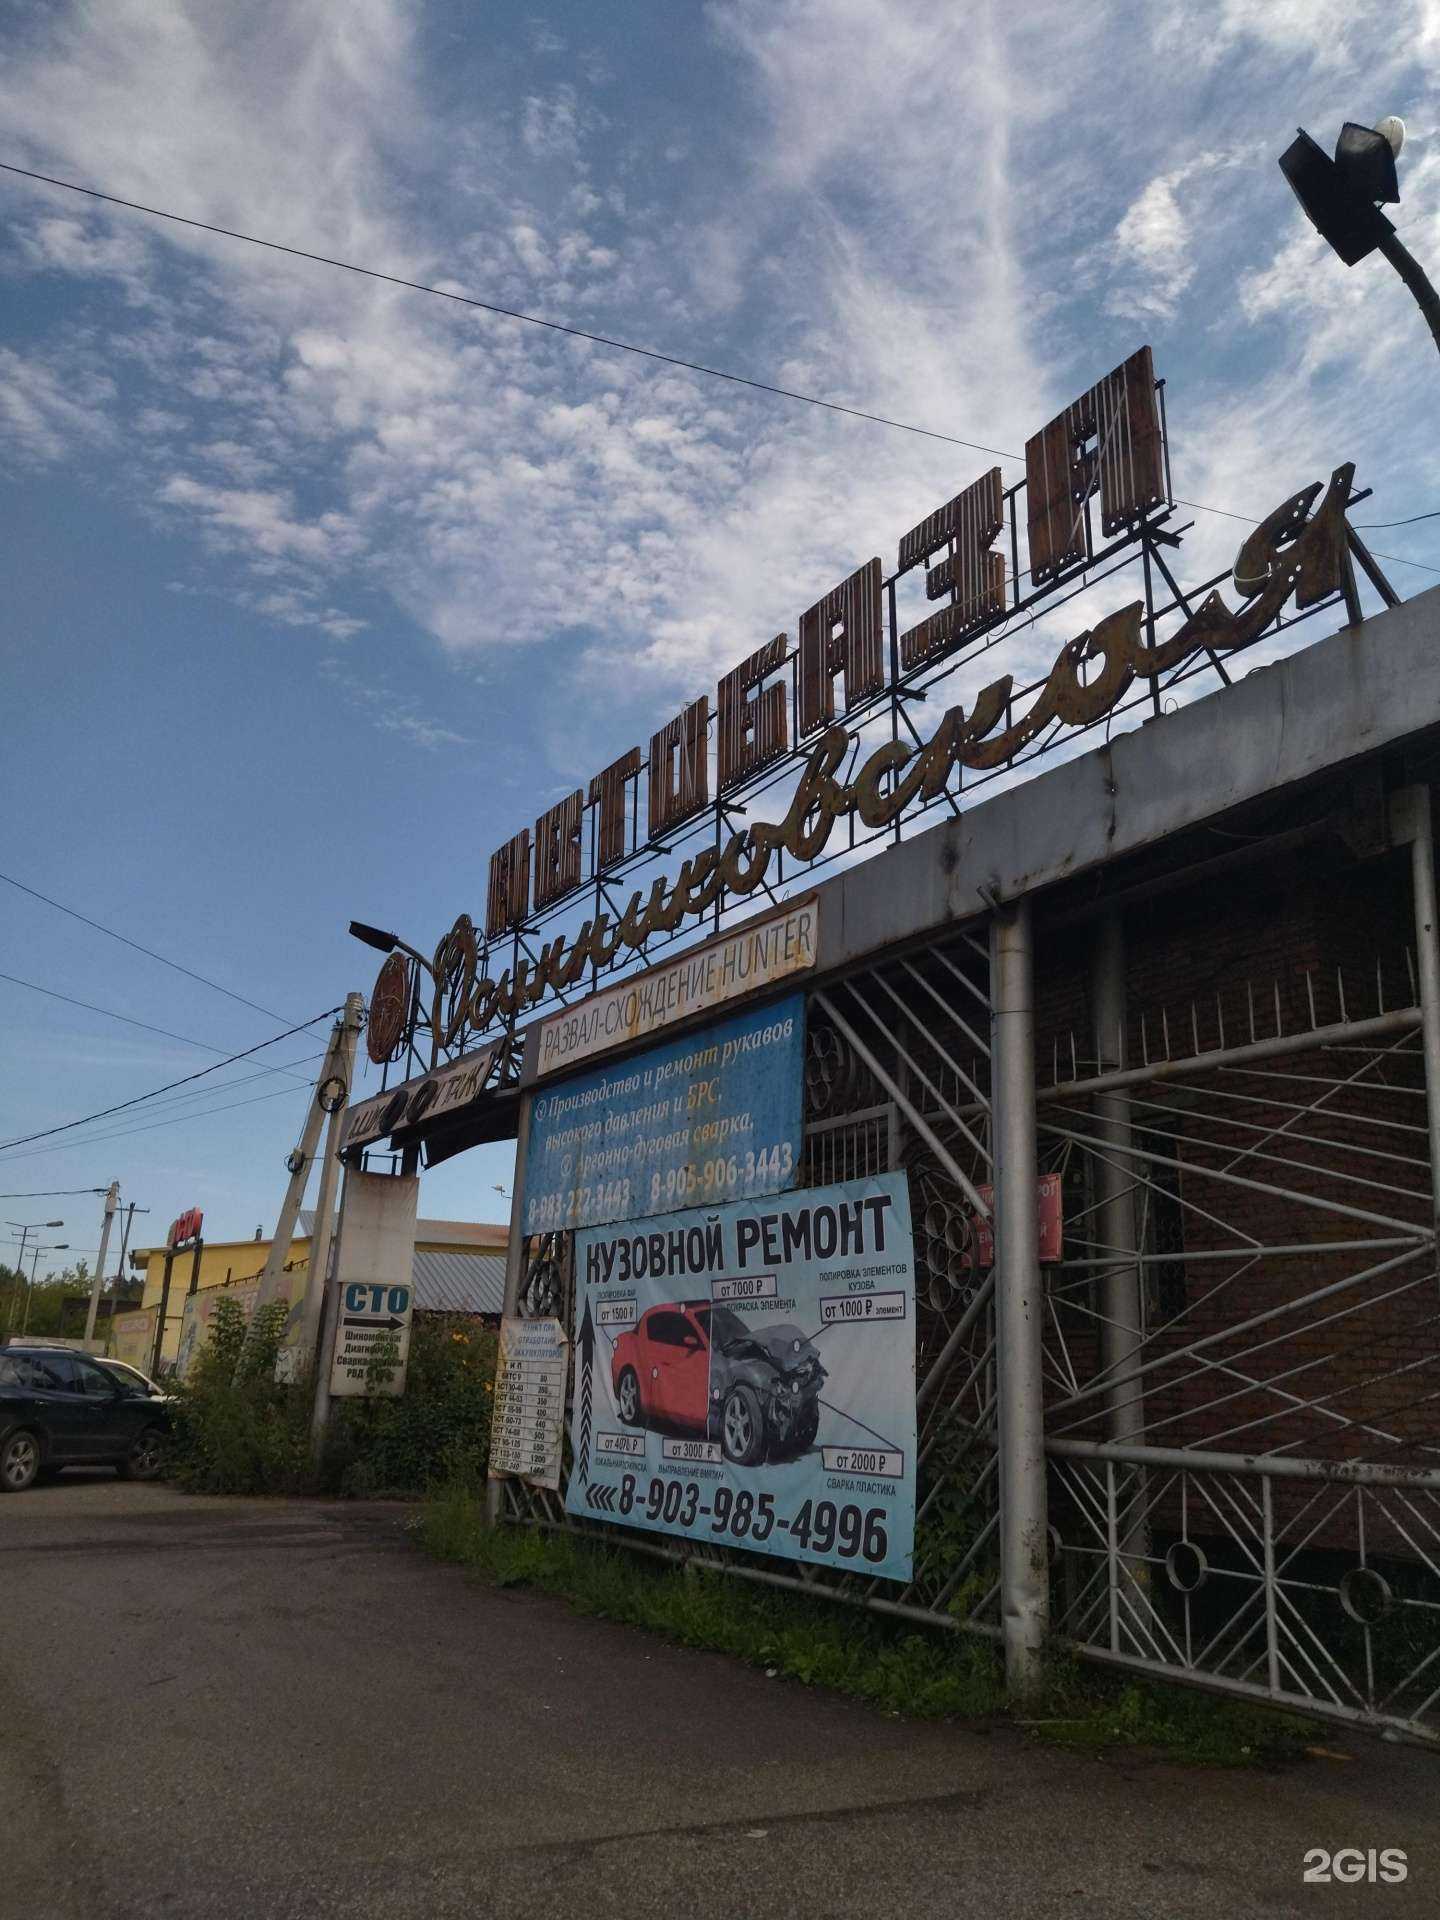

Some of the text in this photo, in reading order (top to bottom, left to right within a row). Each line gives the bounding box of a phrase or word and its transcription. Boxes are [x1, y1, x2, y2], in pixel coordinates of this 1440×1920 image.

[487, 345, 1163, 940] АВТОБАЗА
[543, 912, 812, 1064] РАЗВАЛ-СХОЖДЕНИЕ HUNTER
[548, 1018, 794, 1120] Производство и ремонт рукавов
[545, 1119, 603, 1151] высокого
[604, 1098, 669, 1134] давления
[673, 1095, 684, 1114] и
[586, 1195, 892, 1284] КУЗОВНОЙ РЕМОНТ
[862, 1264, 907, 1278] ЭЛЕМЕНТОВ
[345, 1284, 409, 1313] СТО
[732, 1280, 754, 1295] 7000
[839, 1301, 862, 1317] 1000
[683, 1443, 703, 1458] 3000
[851, 1453, 876, 1471] 2000
[827, 1478, 855, 1492] СВАРКА
[619, 1474, 888, 1562] 8-903-985-4996
